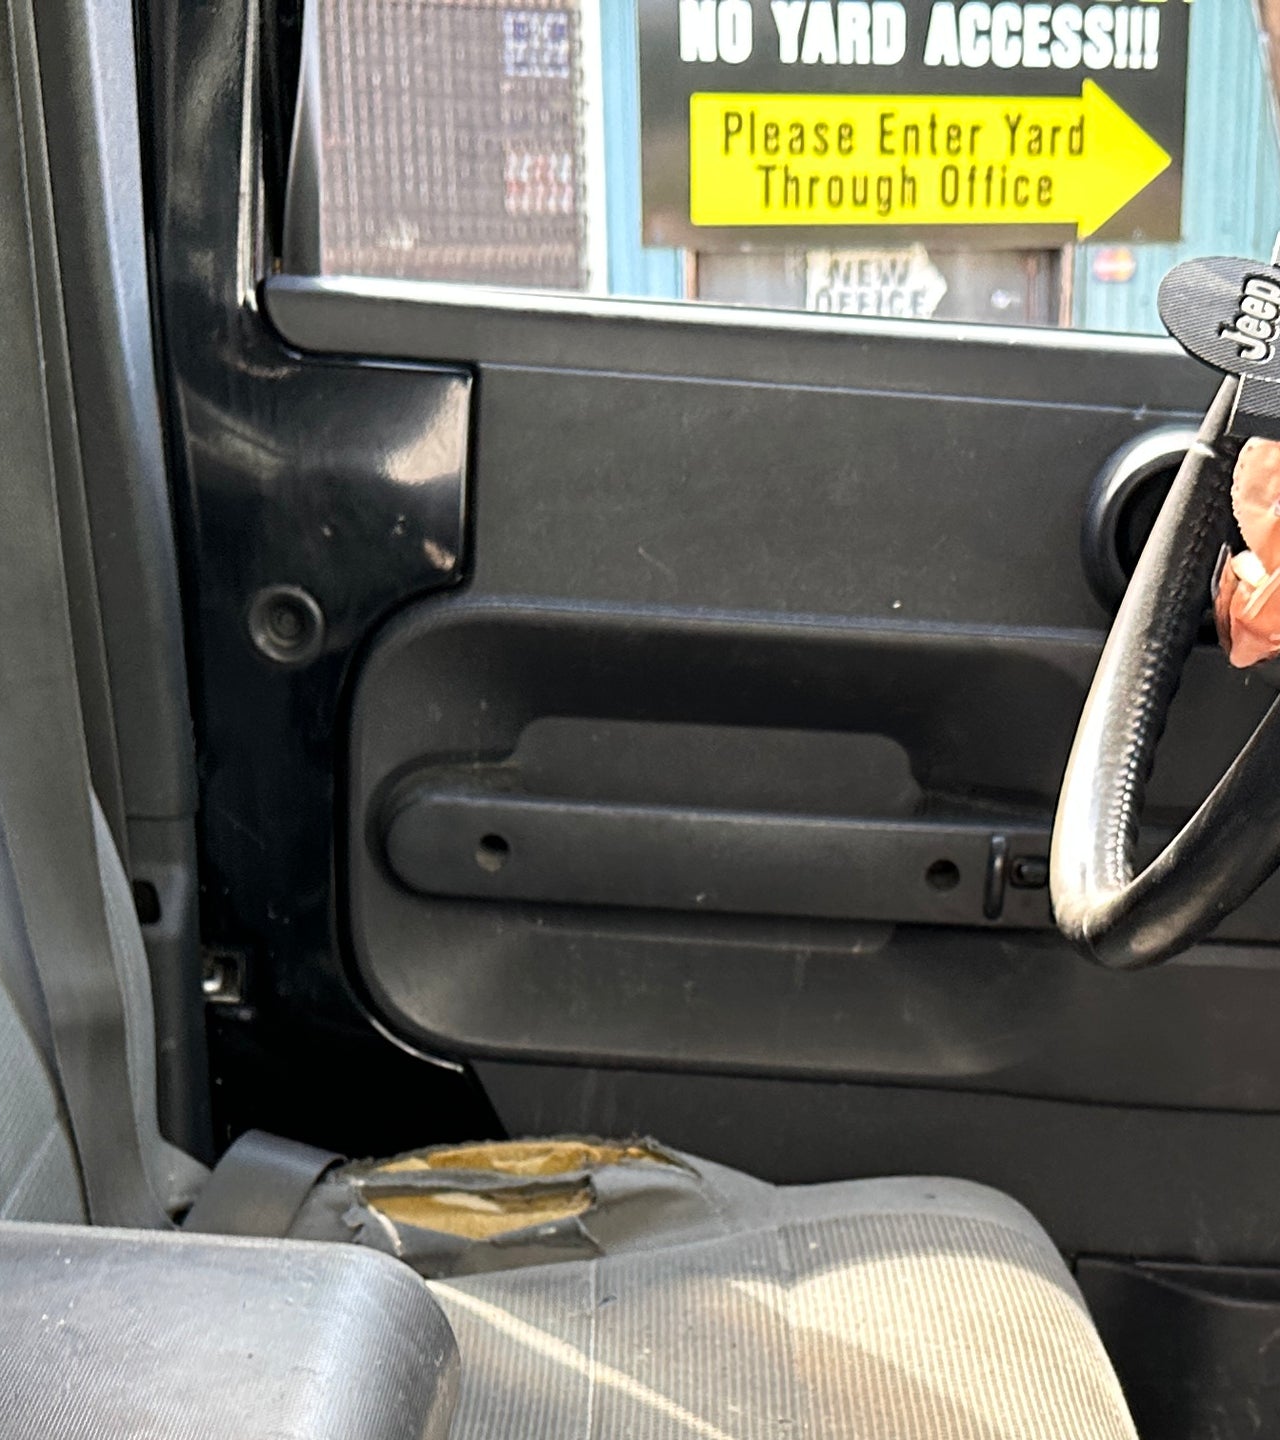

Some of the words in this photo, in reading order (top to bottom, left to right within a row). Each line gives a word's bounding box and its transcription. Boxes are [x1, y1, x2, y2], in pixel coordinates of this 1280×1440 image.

[678, 0, 753, 65] NO
[770, 0, 907, 66] YARD
[923, 1, 1161, 70] ACCESS!!!
[723, 110, 855, 156] Please
[878, 111, 982, 157] Enter
[1003, 112, 1085, 157] Yard
[756, 164, 918, 217] Through
[940, 164, 1054, 208] Office
[828, 258, 911, 287] NEW
